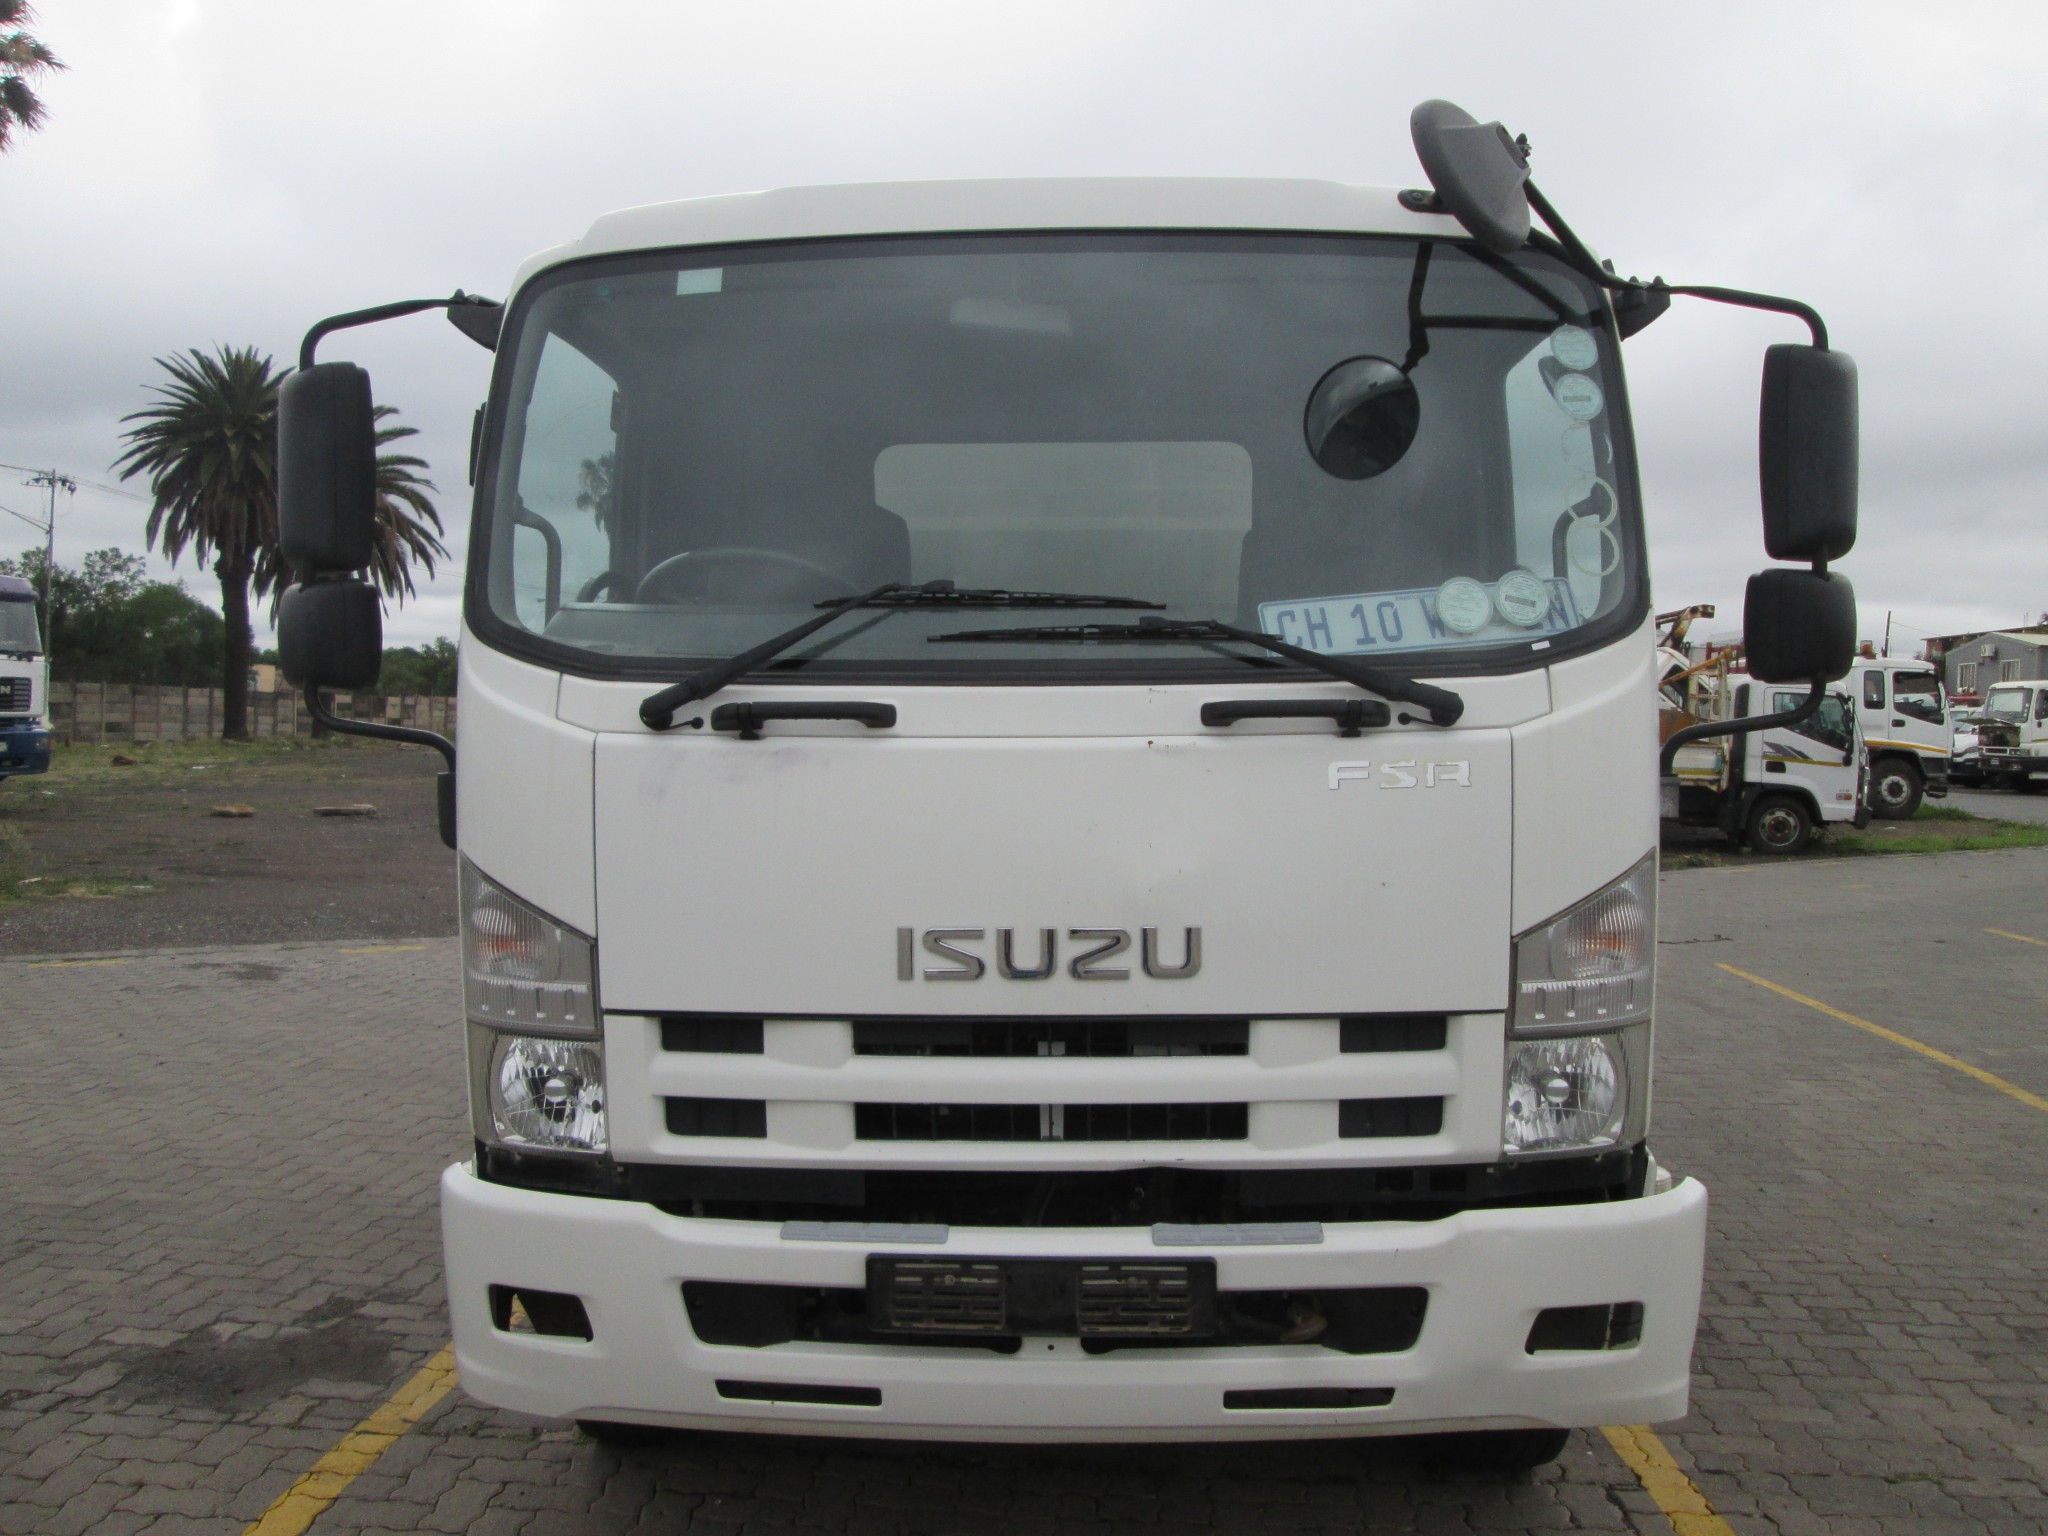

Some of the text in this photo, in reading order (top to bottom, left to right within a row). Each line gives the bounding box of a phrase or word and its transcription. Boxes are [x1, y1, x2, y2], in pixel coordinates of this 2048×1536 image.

[1277, 606, 1333, 650] CH
[1350, 601, 1403, 645] 10
[1328, 760, 1472, 790] FSR
[897, 926, 1202, 980] ISUZU
